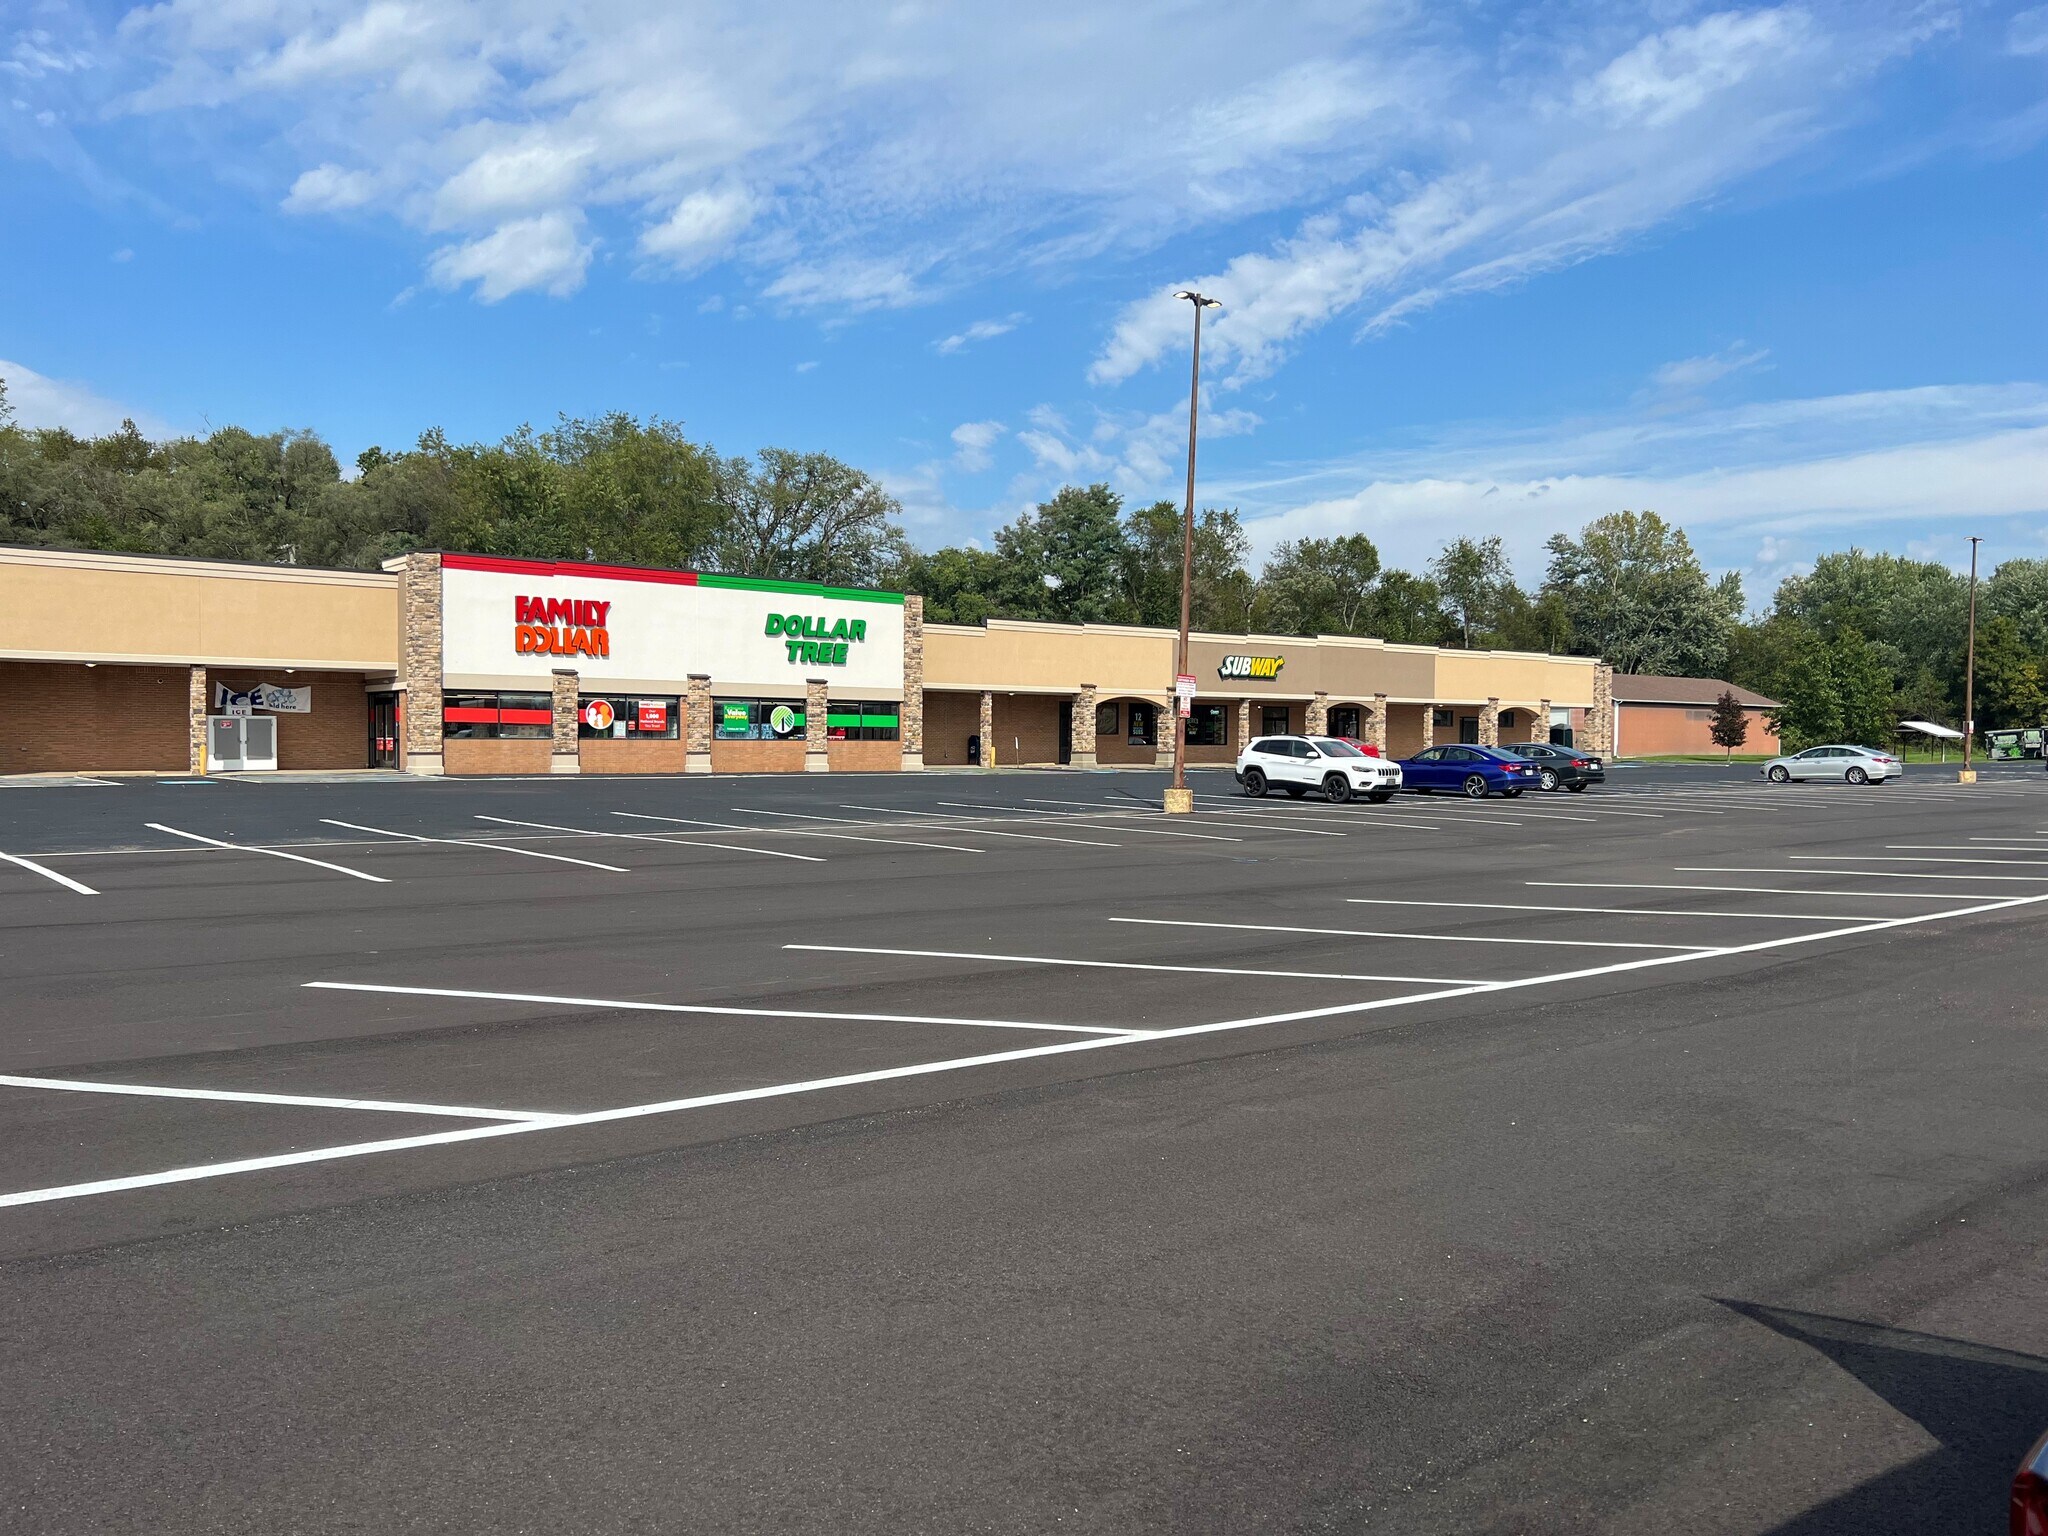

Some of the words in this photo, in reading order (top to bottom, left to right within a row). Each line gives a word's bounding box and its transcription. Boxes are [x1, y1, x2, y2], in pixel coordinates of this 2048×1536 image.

[515, 595, 611, 627] FAMILY
[765, 613, 867, 641] DOLLAR
[515, 624, 609, 656] DOLLAR
[785, 640, 849, 665] TREE
[1219, 655, 1285, 678] SUBWAY
[221, 688, 264, 705] ICE
[1135, 712, 1142, 721] 12
